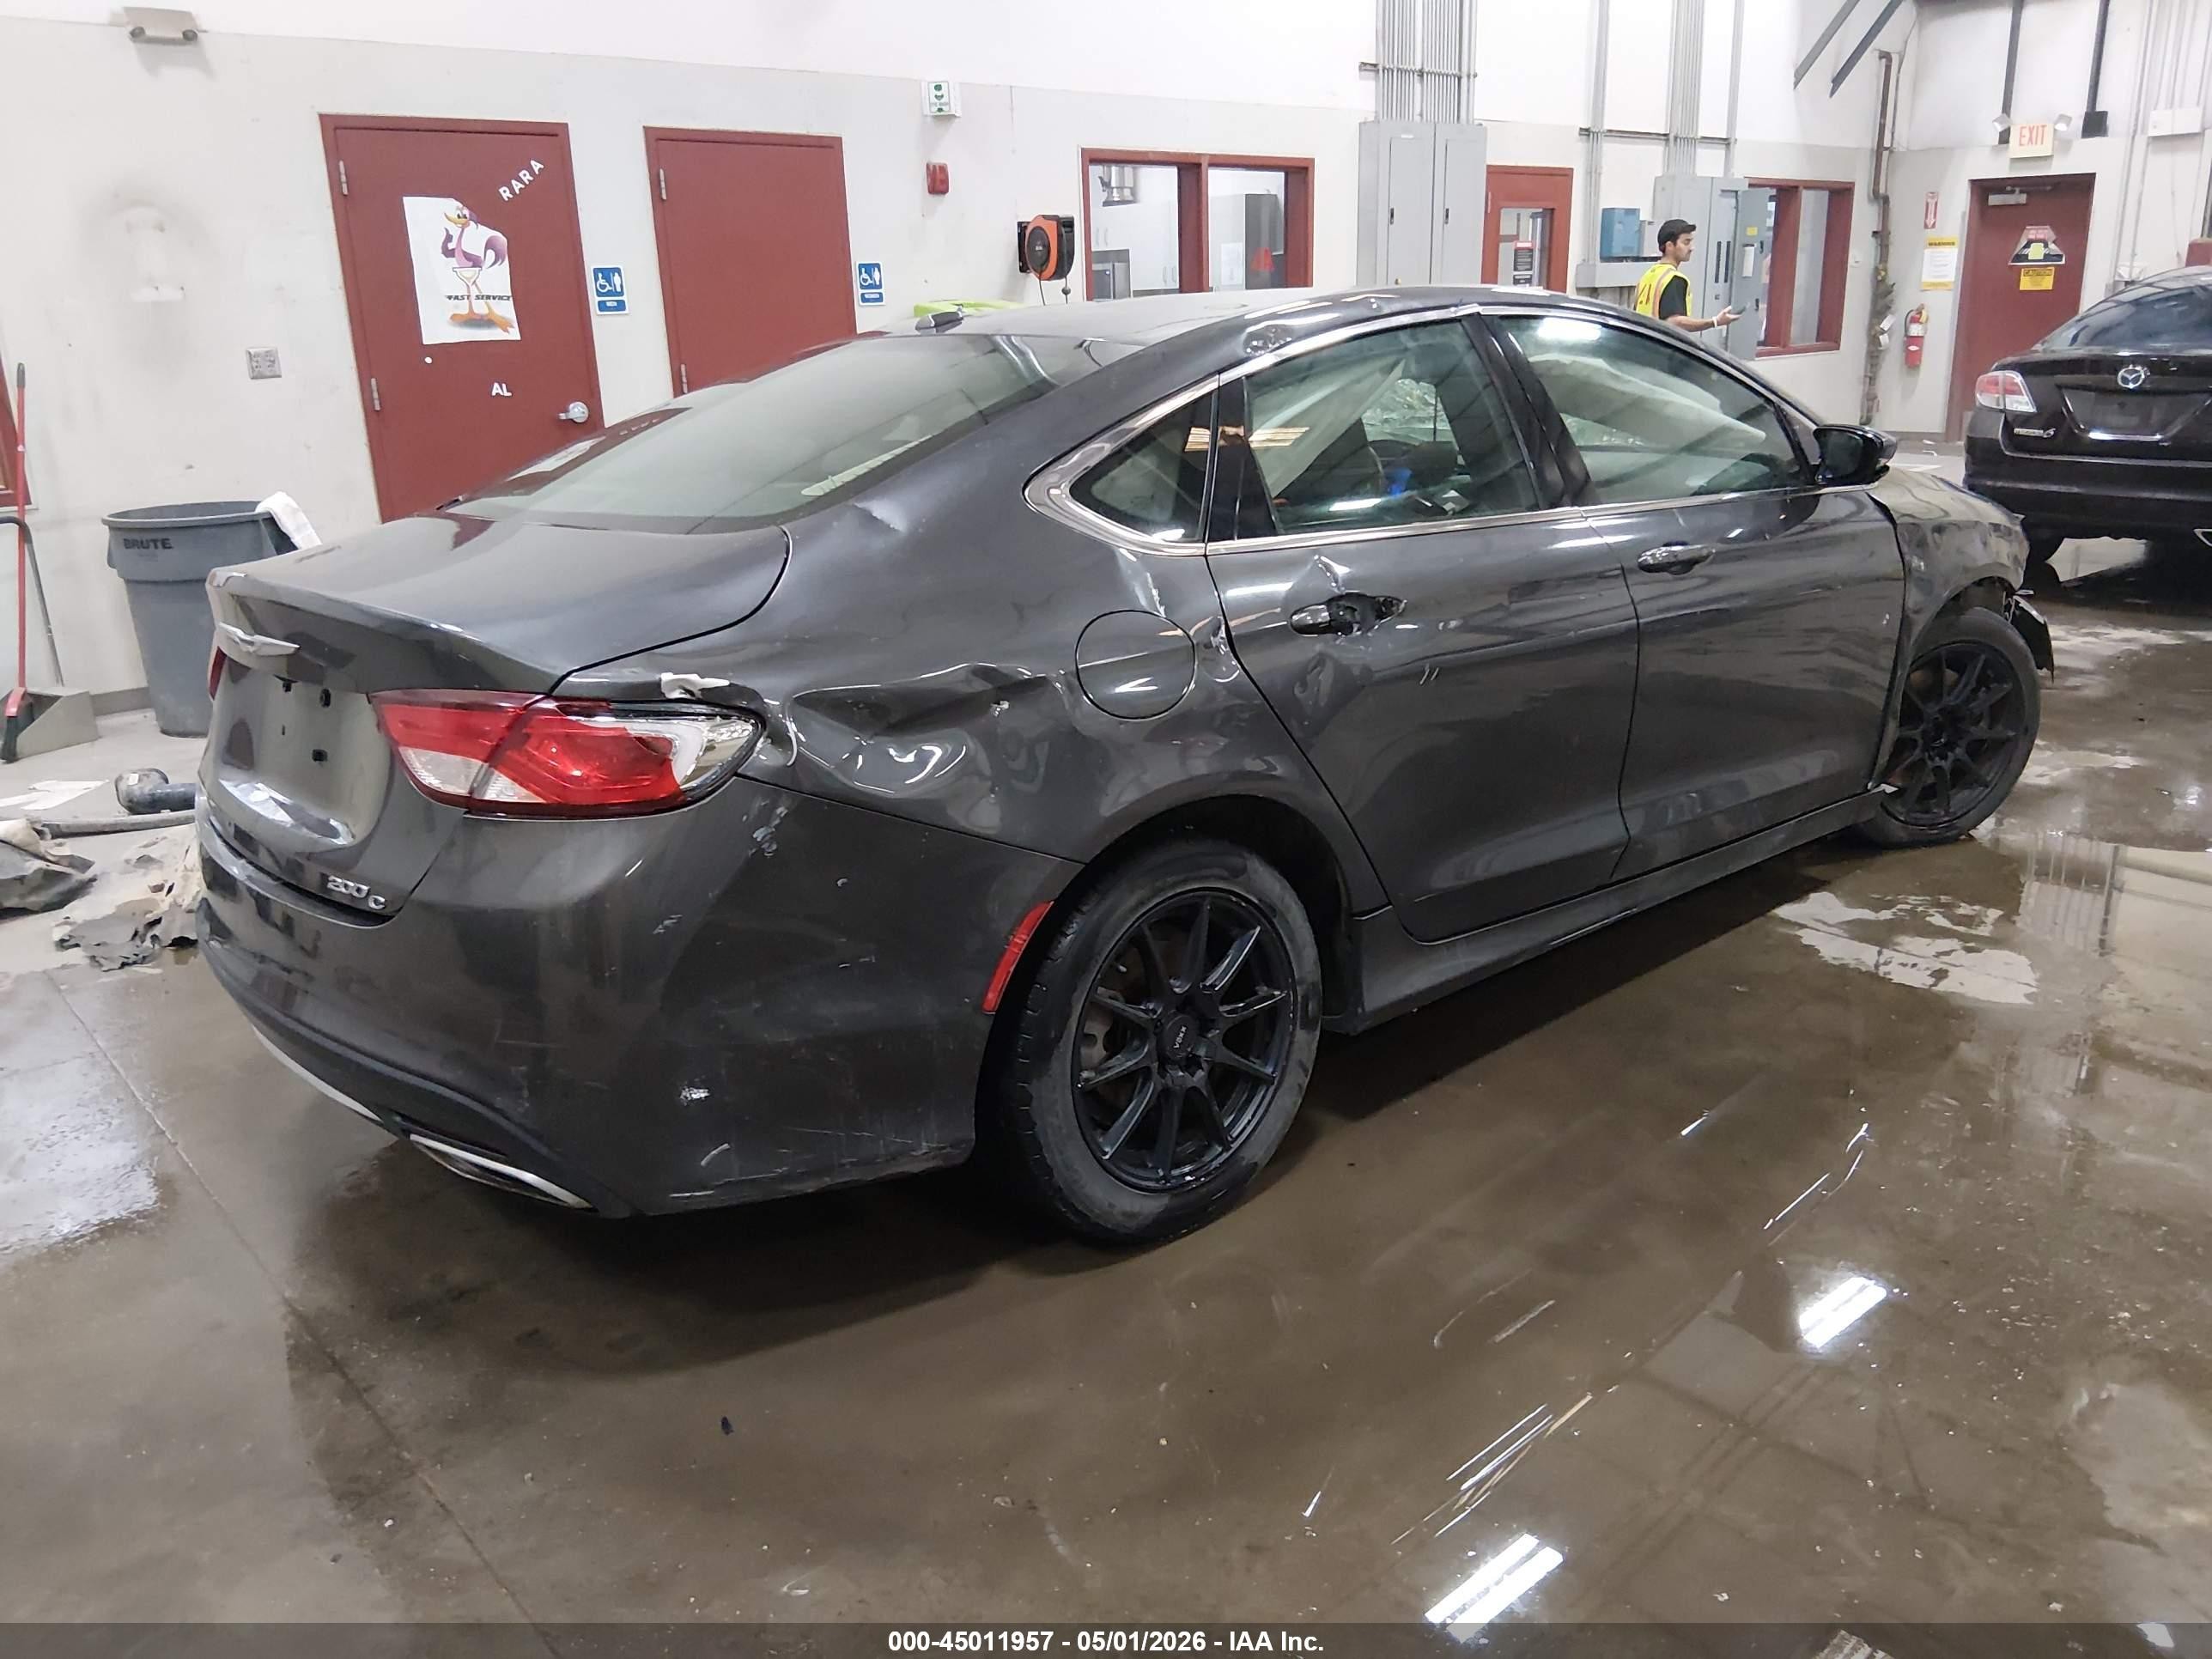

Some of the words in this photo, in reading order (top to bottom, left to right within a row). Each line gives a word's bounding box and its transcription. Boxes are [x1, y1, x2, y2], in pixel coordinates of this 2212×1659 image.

[2019, 125, 2048, 146] EXIT
[498, 160, 544, 201] RARA
[491, 382, 513, 397] AL
[123, 538, 173, 550] BRUTE
[327, 875, 371, 898] 200
